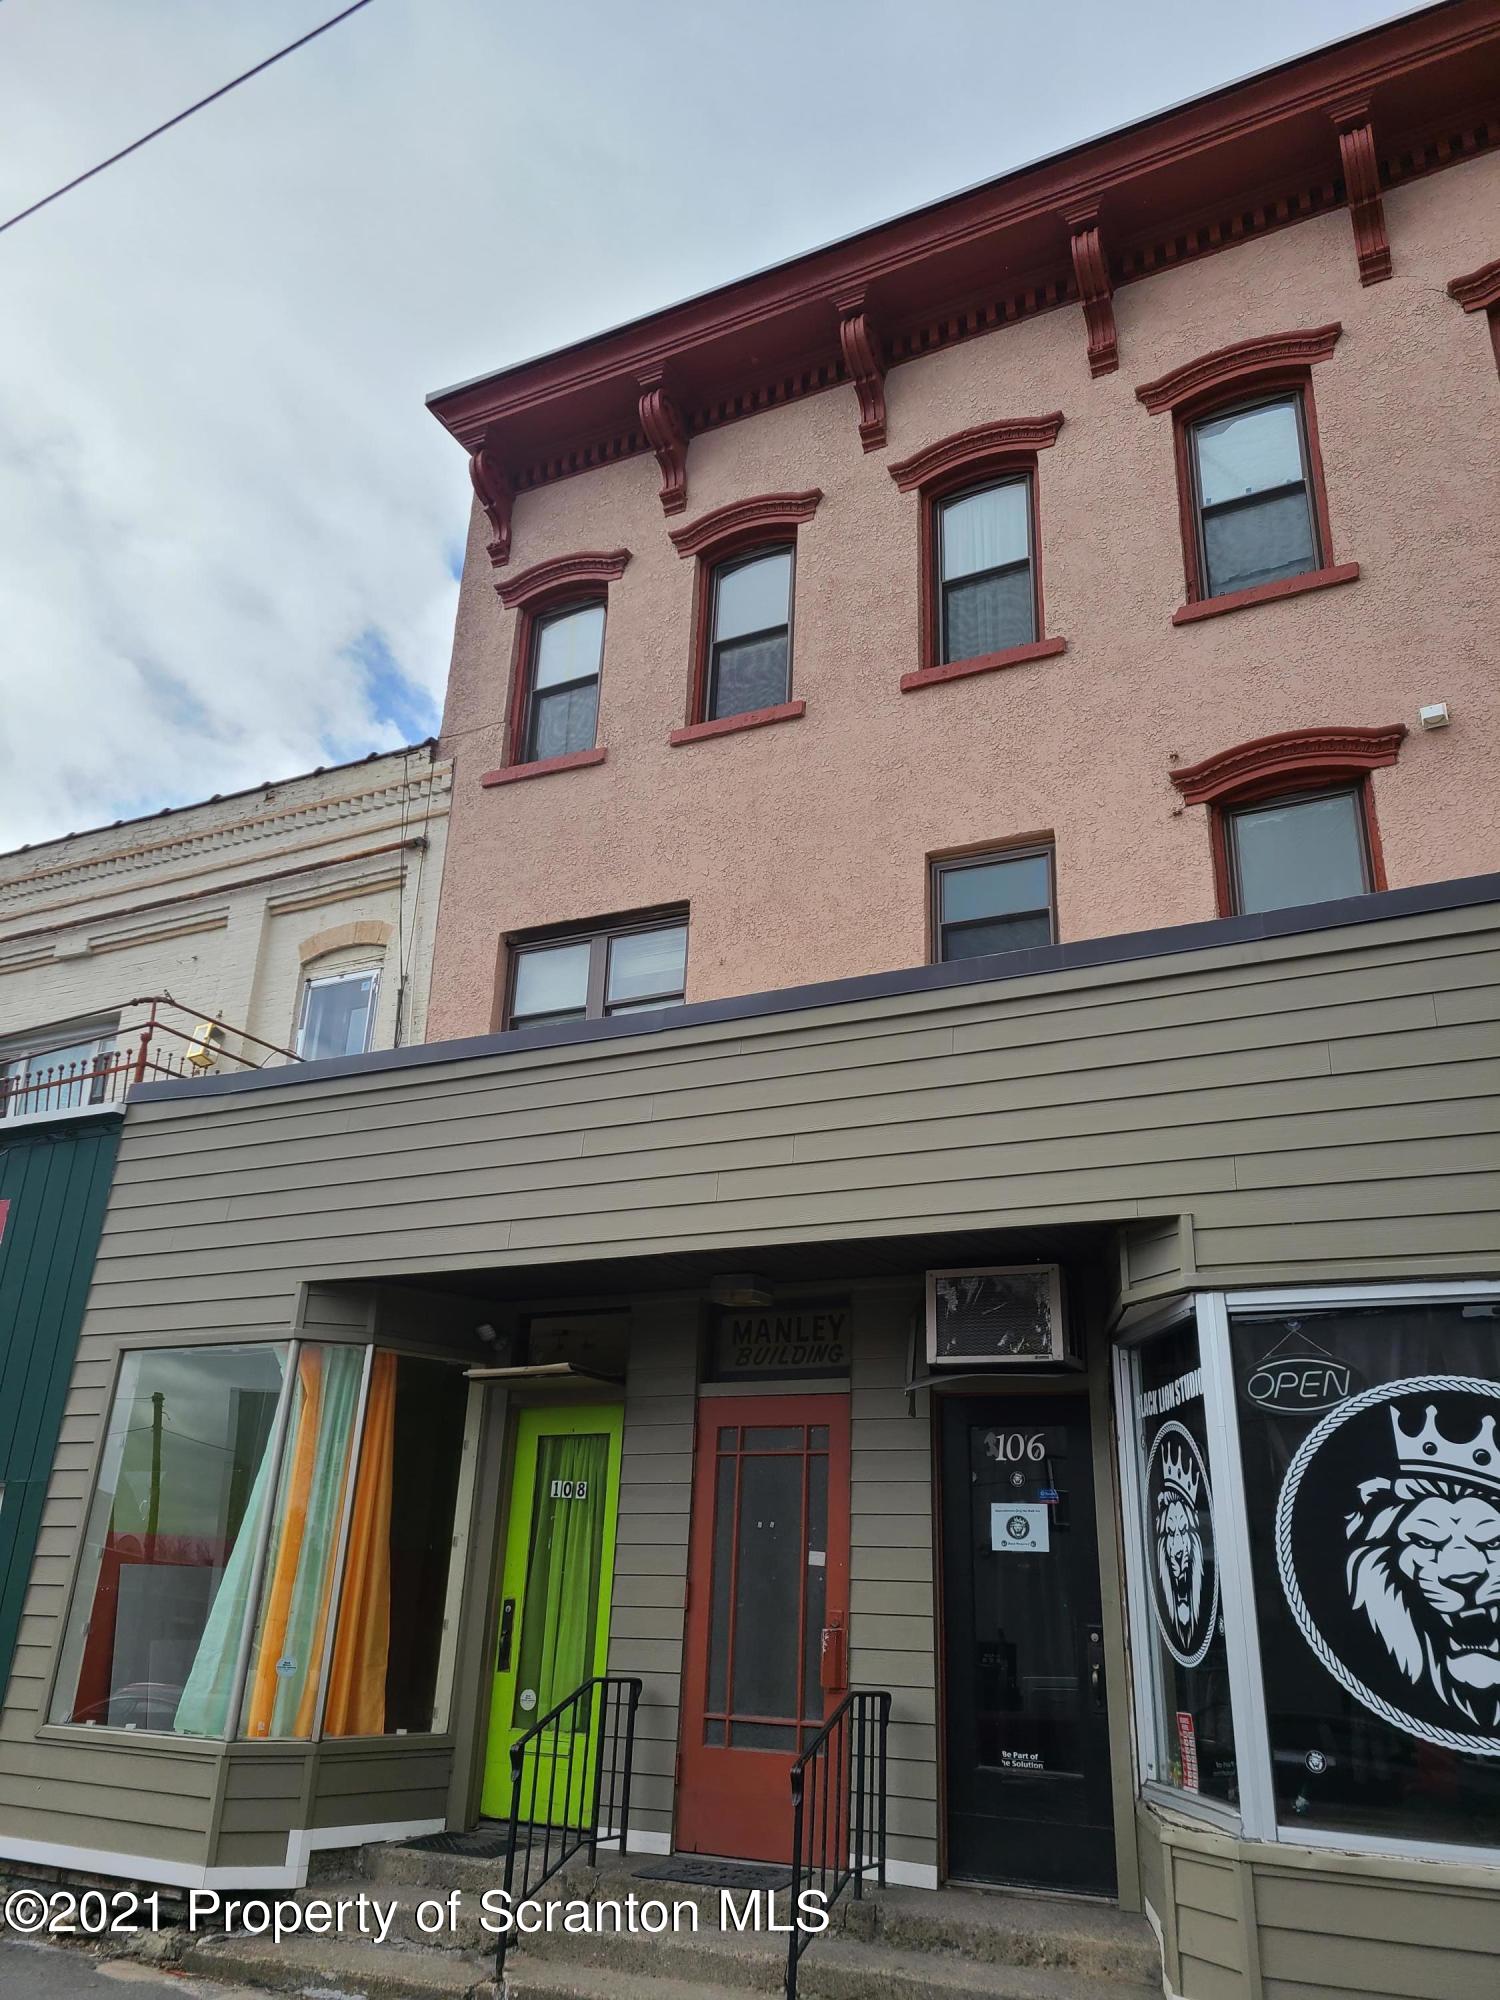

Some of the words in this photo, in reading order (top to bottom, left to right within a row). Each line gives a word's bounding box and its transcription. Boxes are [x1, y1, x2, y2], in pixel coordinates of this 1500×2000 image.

[732, 1313, 845, 1344] MANLEY
[735, 1344, 844, 1366] BUILDING
[1247, 1369, 1350, 1400] OPEN
[1136, 1386, 1158, 1419] BLACK
[1158, 1382, 1175, 1413] LION
[995, 1433, 1046, 1462] 106
[552, 1481, 586, 1498] 108
[1011, 1760, 1044, 1769] Solution
[1013, 1751, 1029, 1760] Part
